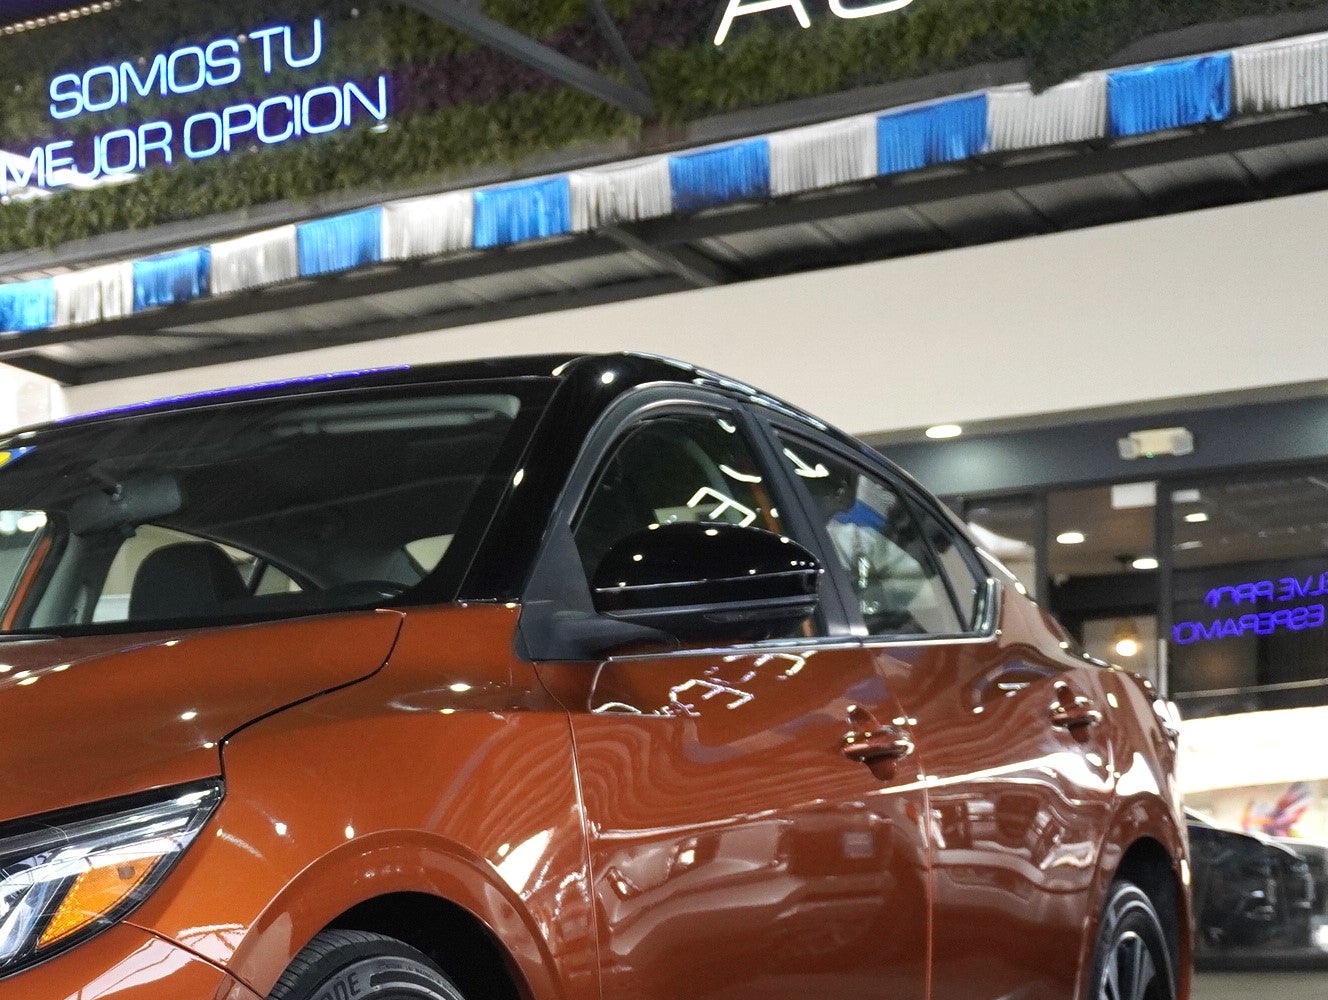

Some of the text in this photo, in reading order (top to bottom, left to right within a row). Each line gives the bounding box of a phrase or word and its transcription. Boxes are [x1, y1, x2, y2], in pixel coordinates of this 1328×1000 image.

[50, 18, 323, 119] SOMOS TU
[183, 76, 388, 160] OPCION
